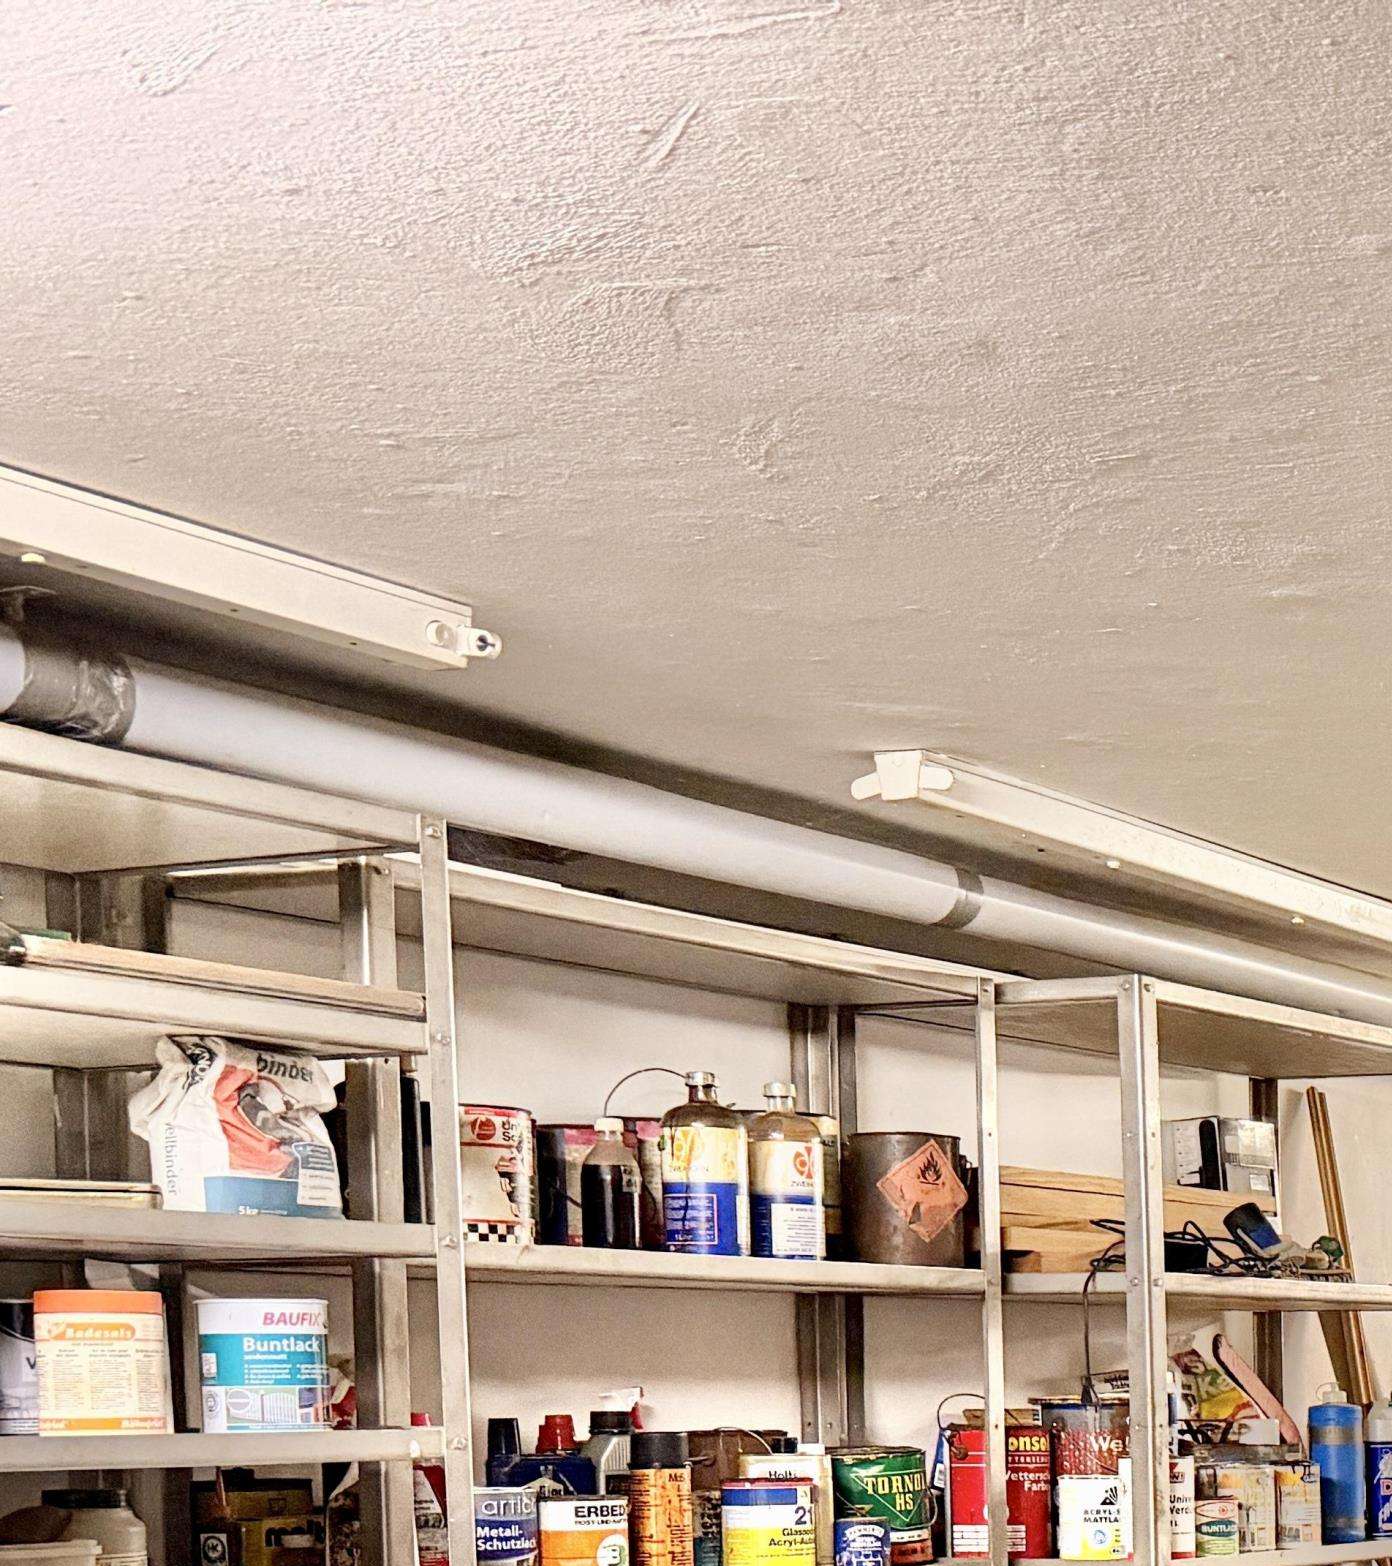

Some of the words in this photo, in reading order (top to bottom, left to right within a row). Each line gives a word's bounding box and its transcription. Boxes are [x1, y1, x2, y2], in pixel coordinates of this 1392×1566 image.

[262, 1312, 321, 1327] BAUFIX
[243, 1336, 320, 1352] Buntlack
[895, 1493, 914, 1511] HS
[476, 1526, 524, 1538] Metall-
